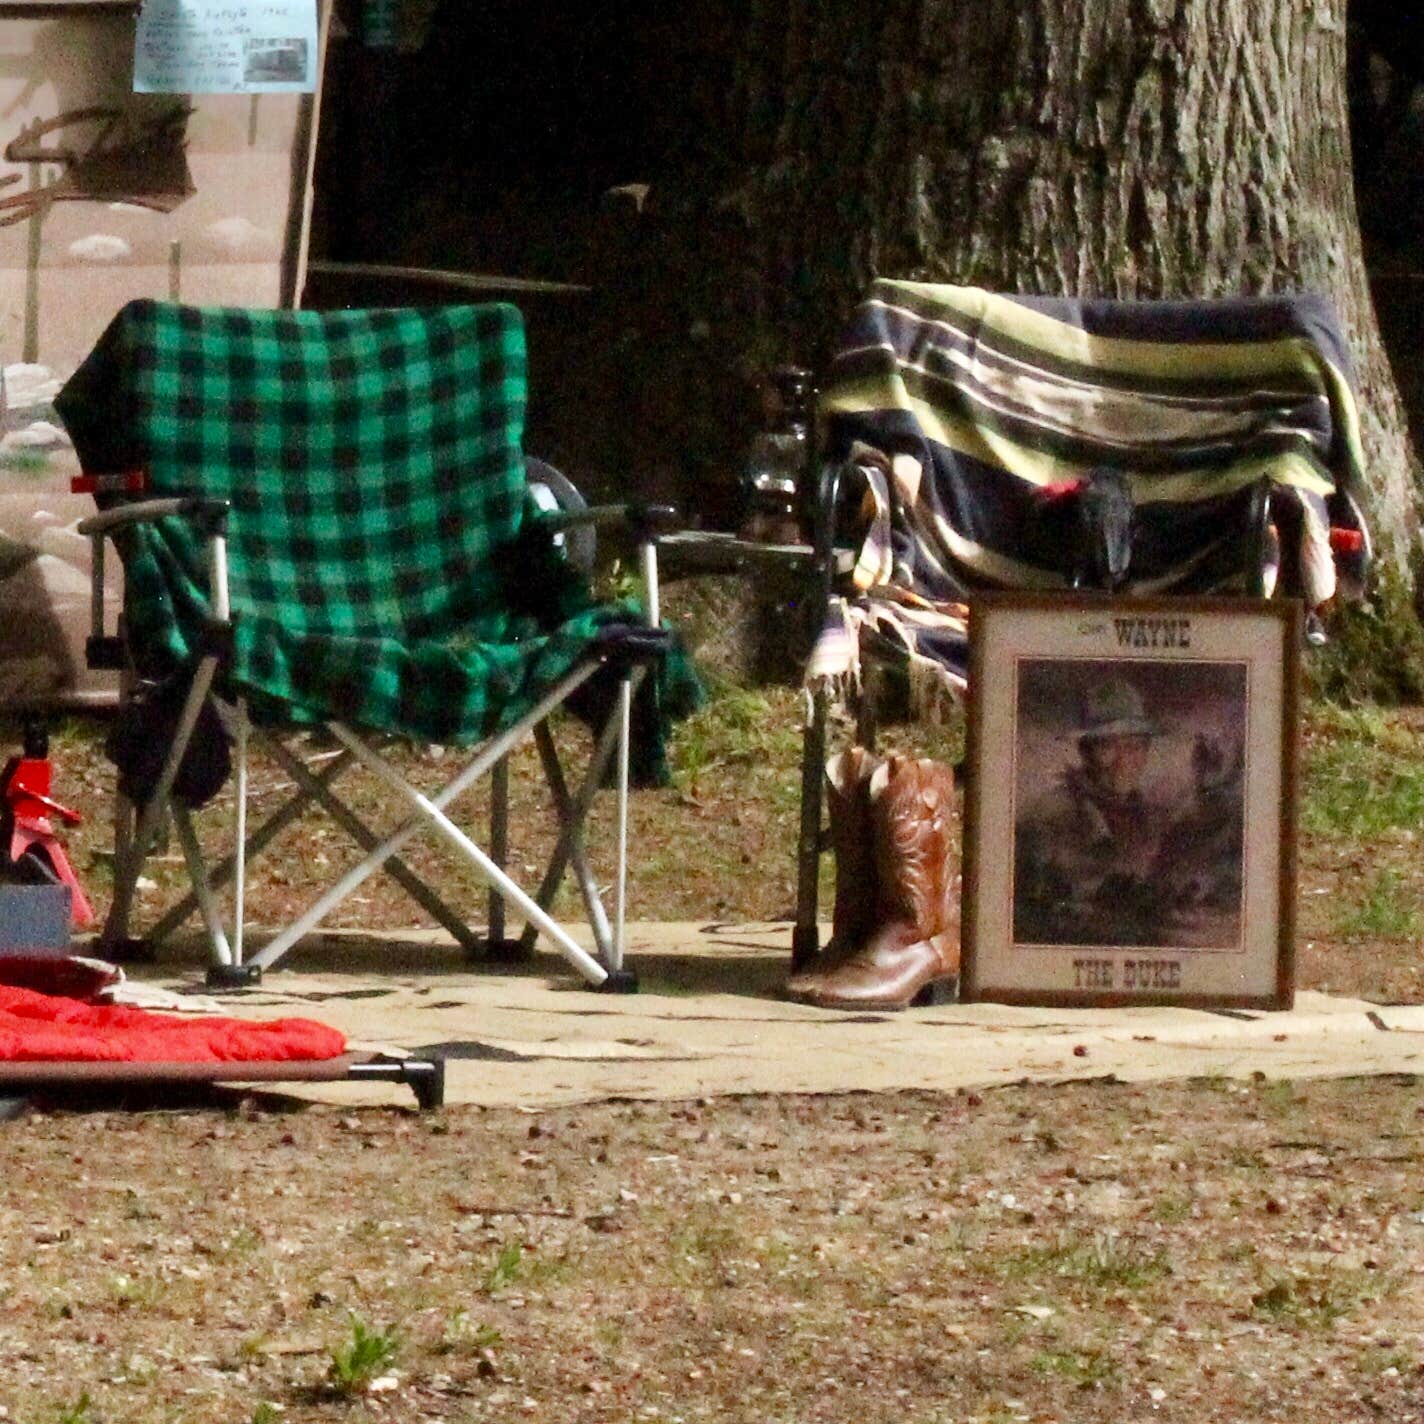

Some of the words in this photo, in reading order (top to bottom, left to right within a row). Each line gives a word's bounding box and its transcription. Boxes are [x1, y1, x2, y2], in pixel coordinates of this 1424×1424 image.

[1114, 618, 1190, 648] WAYNE
[1073, 959, 1113, 987] THE
[1124, 959, 1180, 988] DUKE
